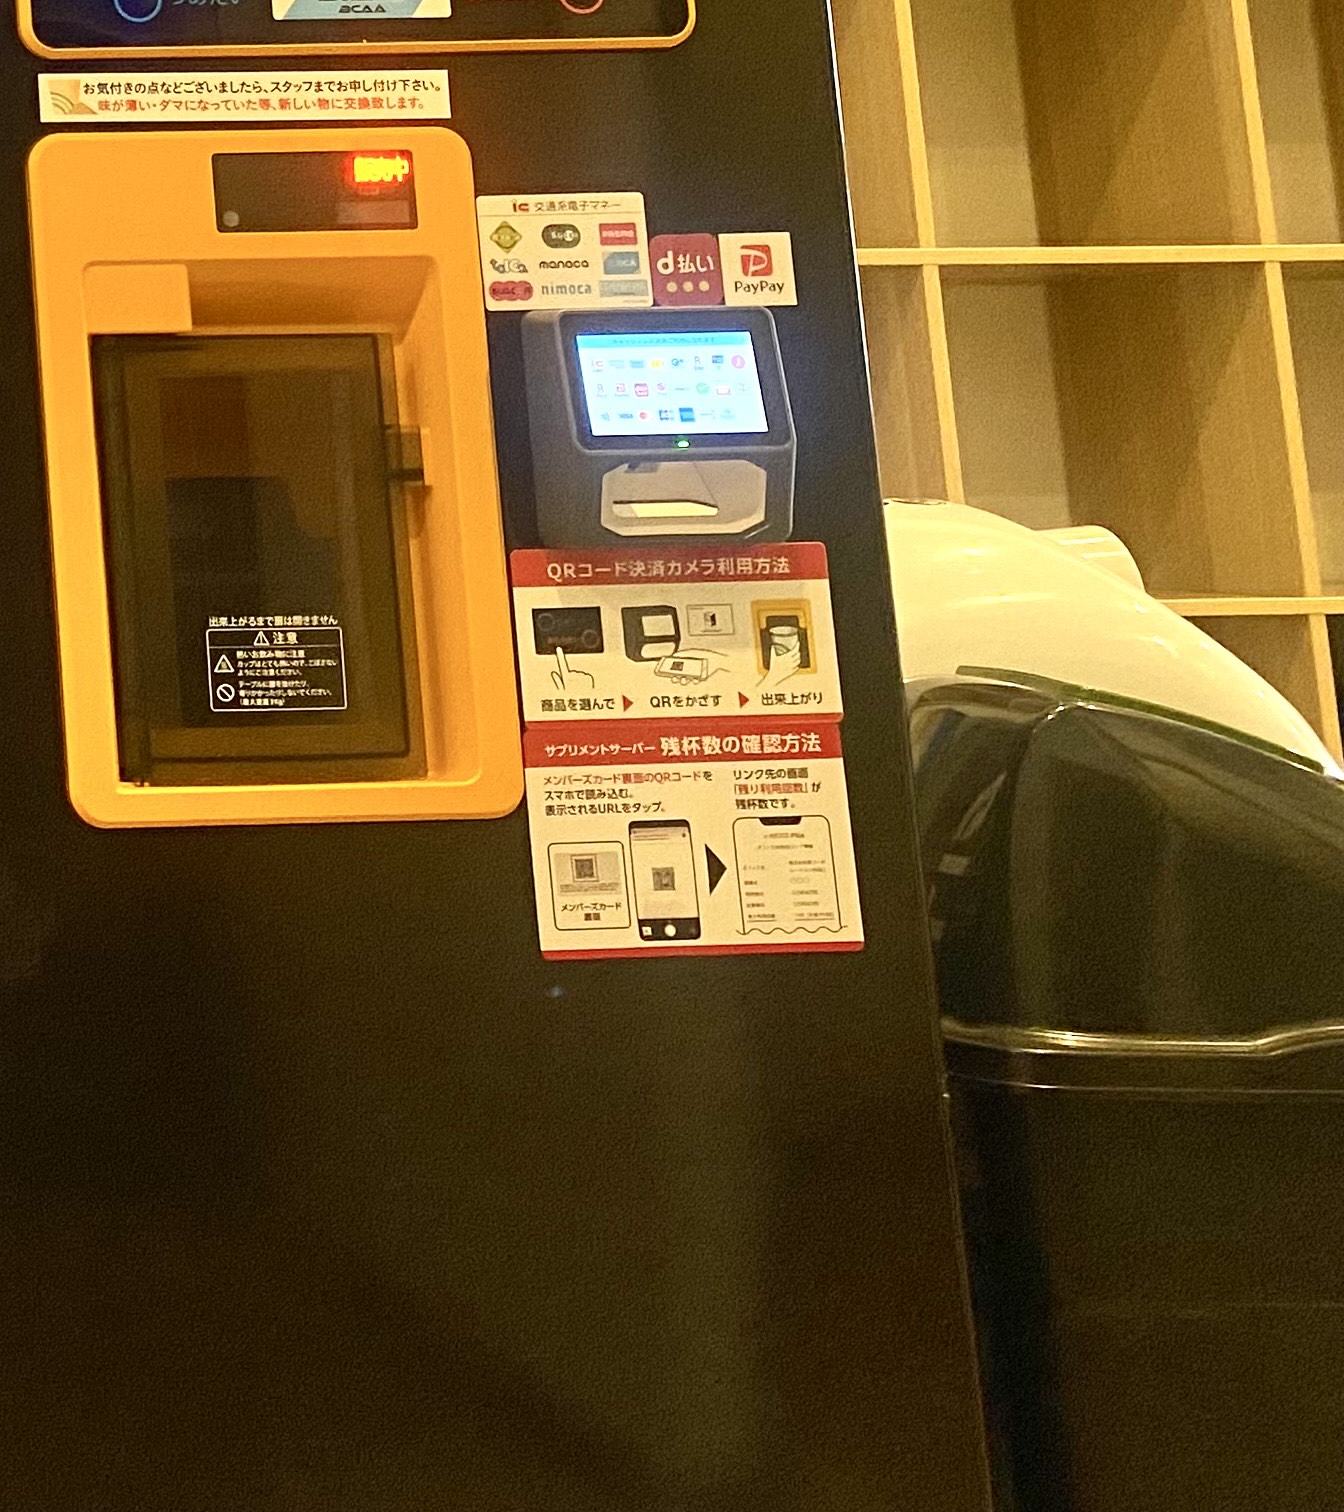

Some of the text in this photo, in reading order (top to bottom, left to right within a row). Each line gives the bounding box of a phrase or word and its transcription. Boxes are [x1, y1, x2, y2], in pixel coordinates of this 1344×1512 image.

[534, 199, 621, 212] 交通系電子マネー
[657, 250, 714, 274] d払い
[735, 280, 784, 294] PayPay
[547, 558, 791, 582] QRコード決済カメラ利用方法
[273, 631, 298, 644] 注意
[541, 697, 615, 712] 商品を選んで
[650, 694, 722, 709] QRをかざす
[761, 692, 823, 706] 出来上がり
[545, 732, 822, 758] サプリメントサーバー 残杯数の確認方法
